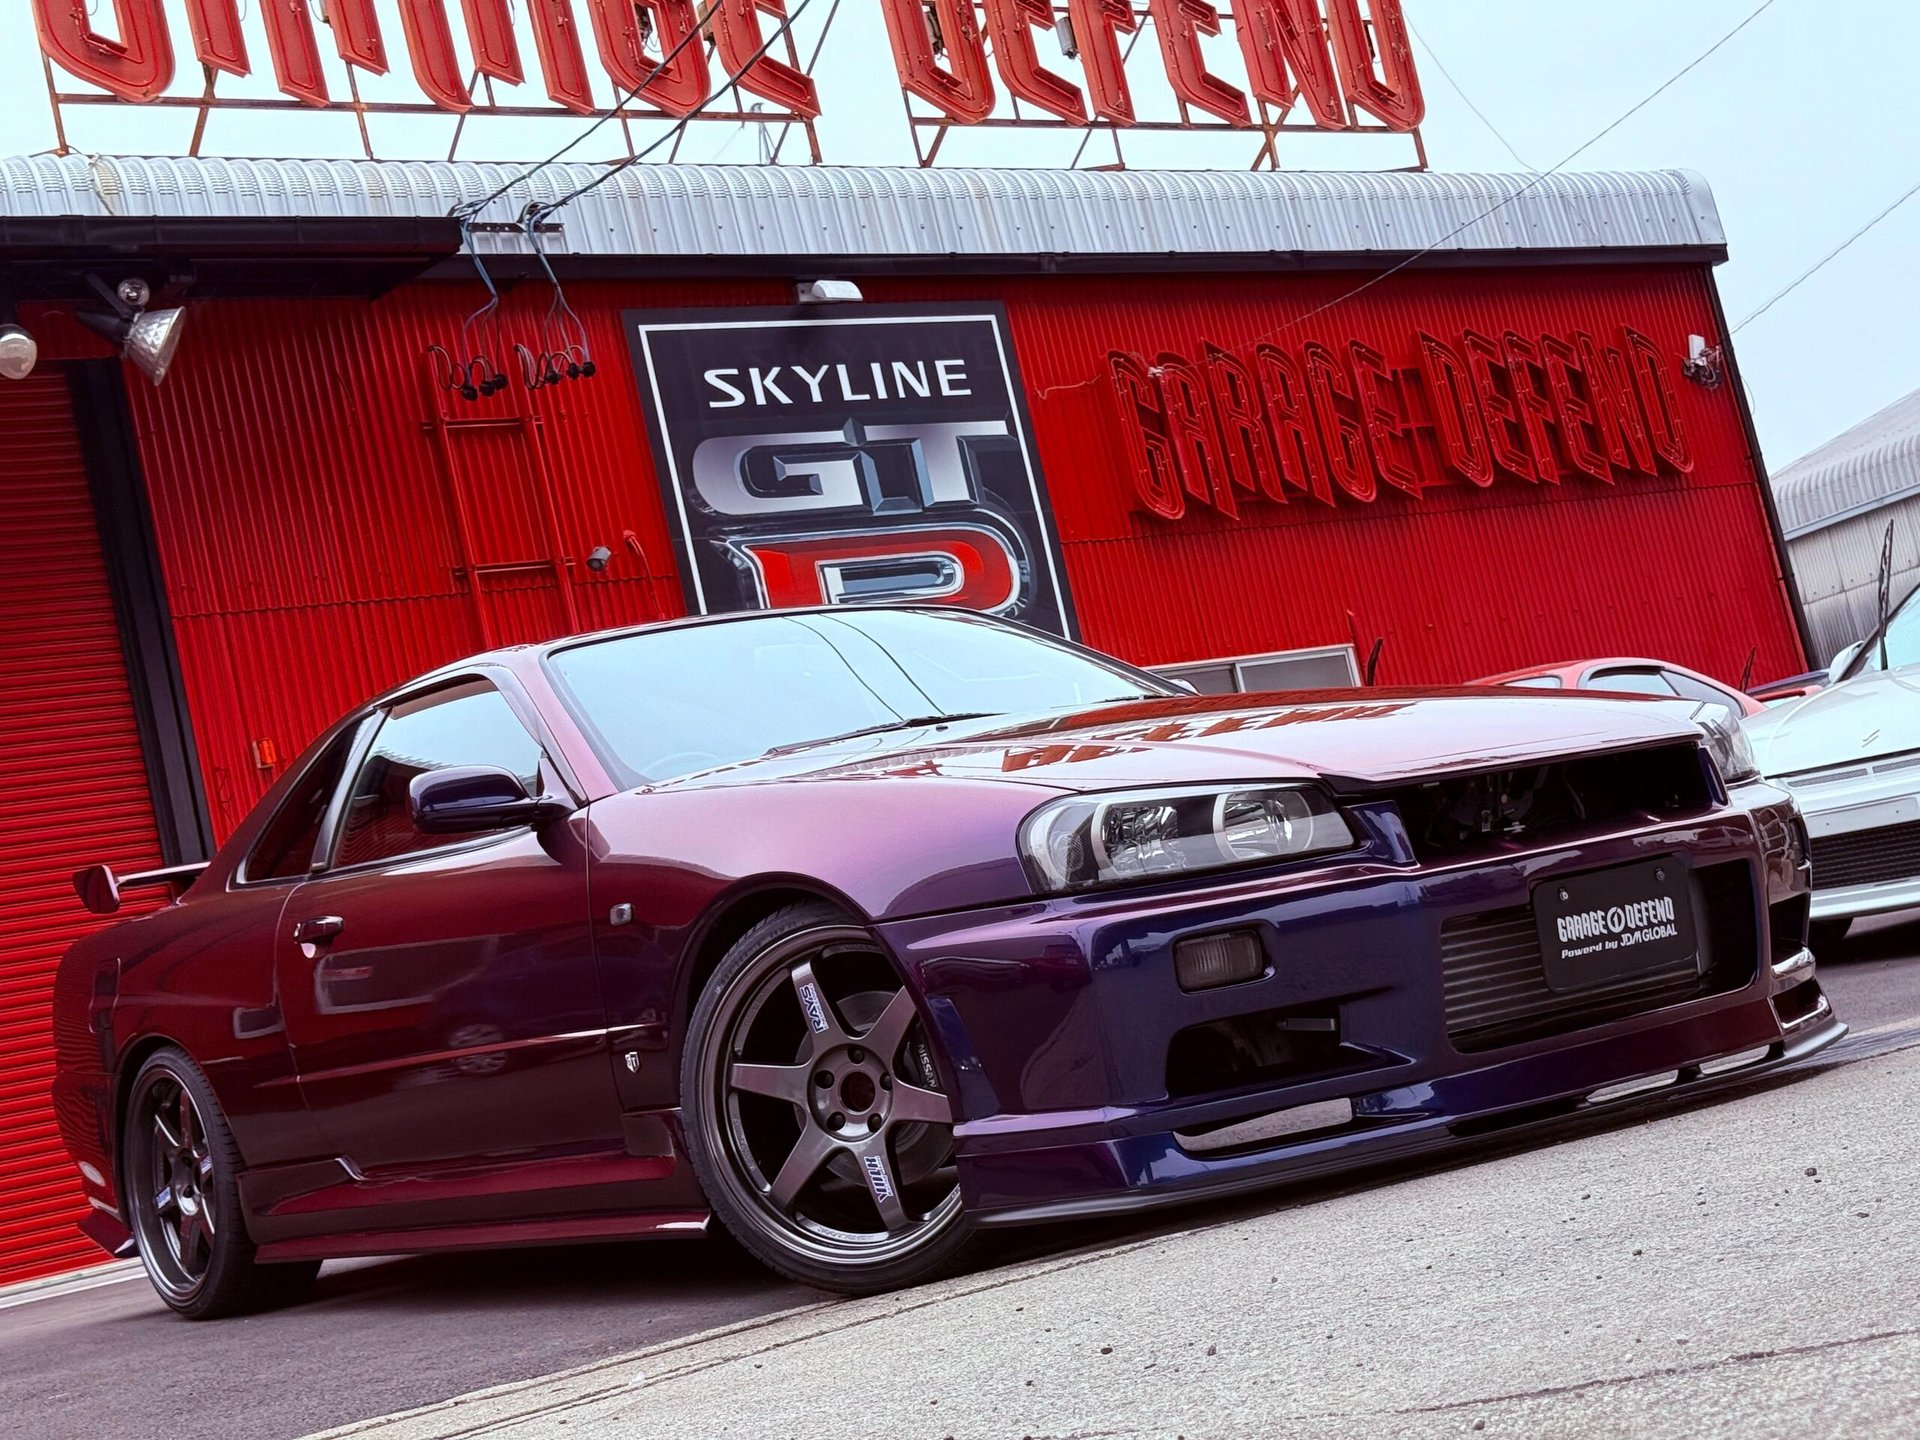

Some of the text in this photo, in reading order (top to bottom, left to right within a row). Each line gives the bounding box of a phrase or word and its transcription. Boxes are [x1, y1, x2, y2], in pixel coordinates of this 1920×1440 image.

[703, 359, 972, 408] SKYLINE
[1106, 323, 1694, 521] GARAGE DEFEND
[692, 417, 1010, 517] GT
[1557, 896, 1676, 942] GARAGE DEFEND
[1604, 940, 1619, 950] by
[800, 985, 824, 1033] RAYS
[918, 1043, 937, 1088] NISSAN
